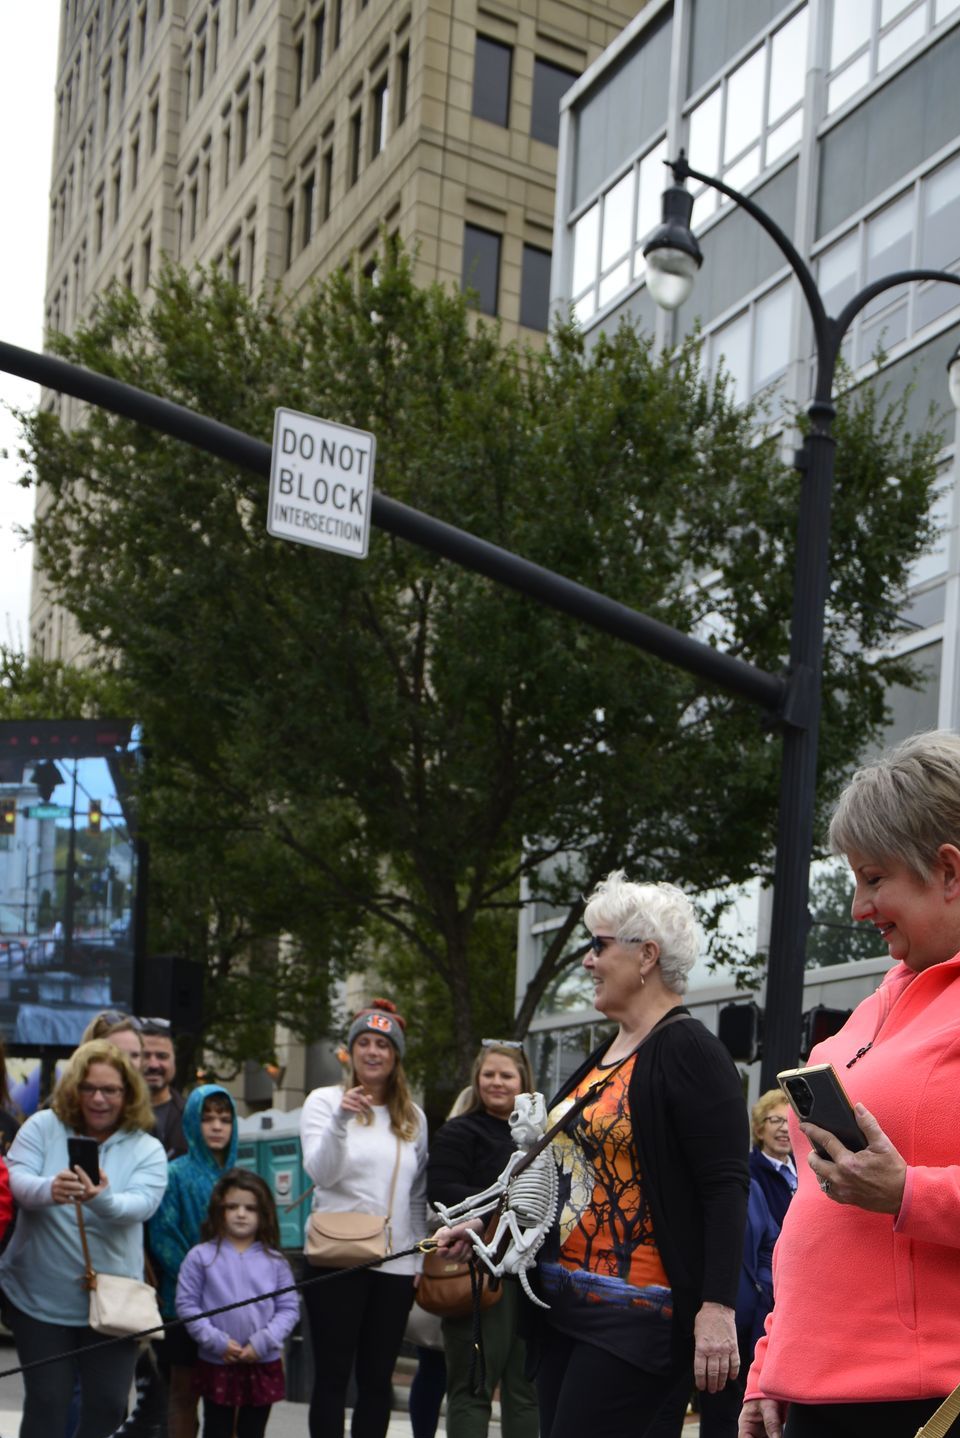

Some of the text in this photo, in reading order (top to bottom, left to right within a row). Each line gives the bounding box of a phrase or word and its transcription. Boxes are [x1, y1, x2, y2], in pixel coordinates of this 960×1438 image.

[282, 428, 367, 475] DO NOT
[278, 468, 363, 515] BLOCK
[274, 503, 361, 542] INTERSECTION
